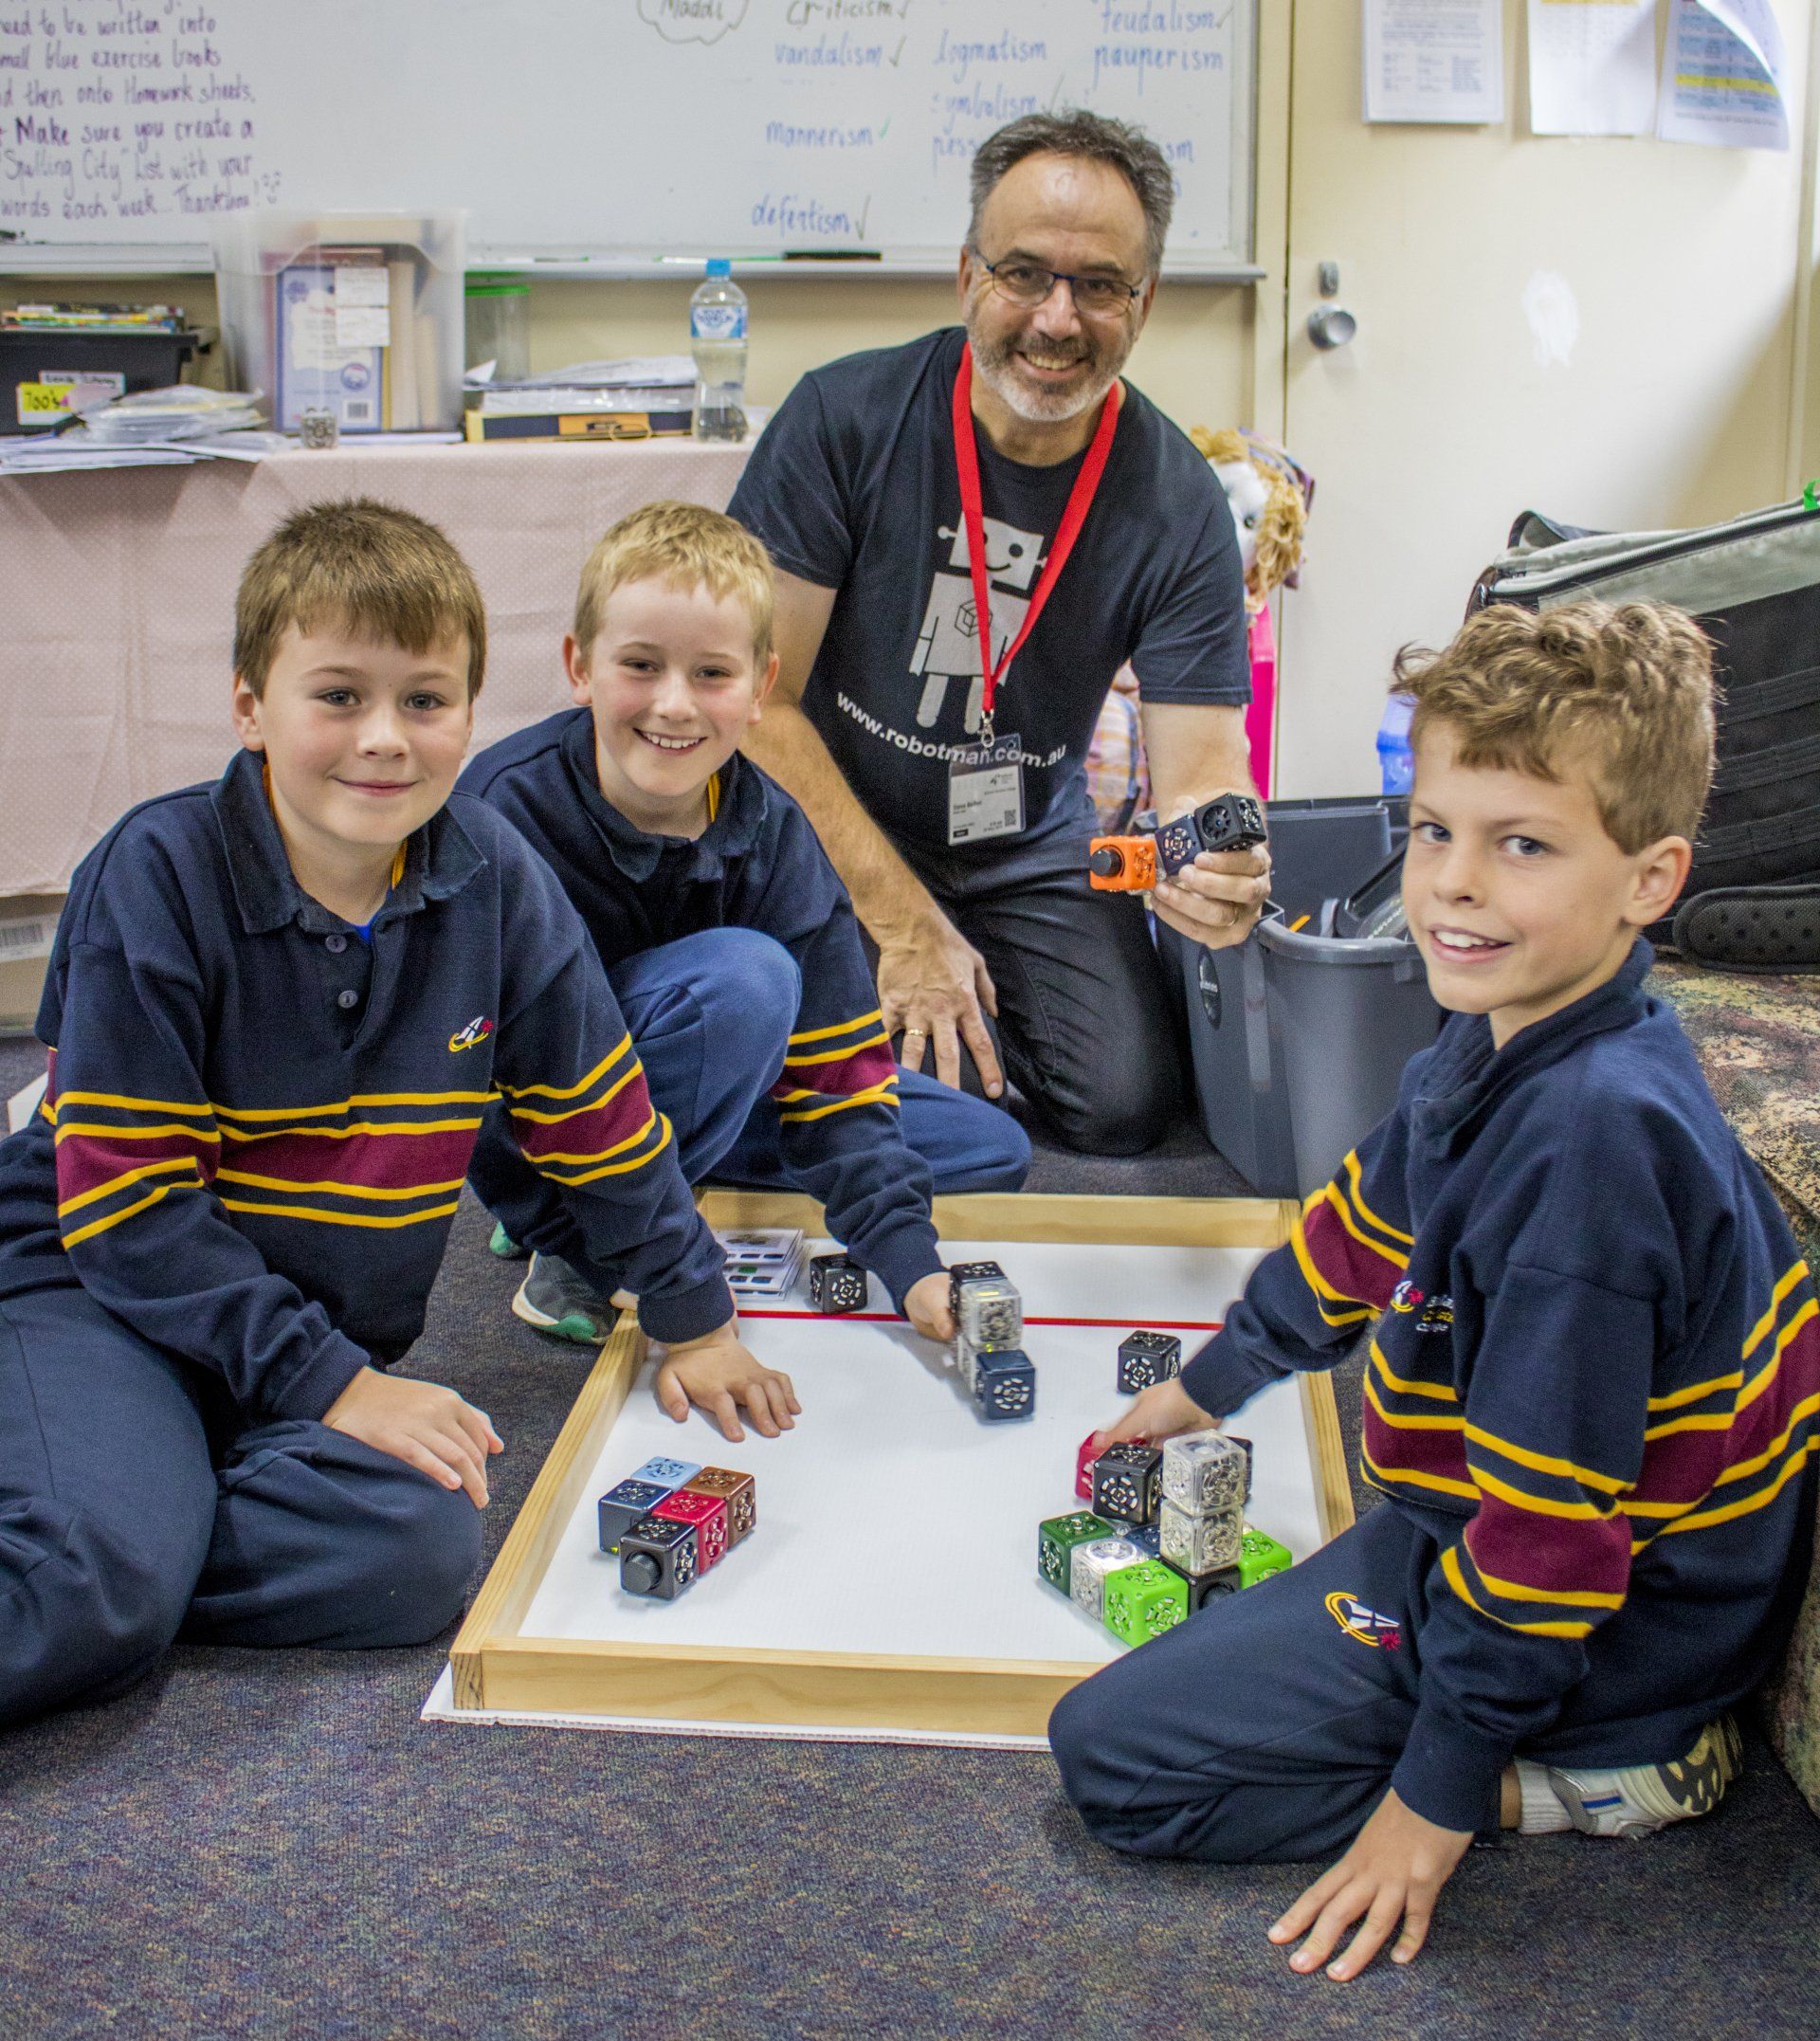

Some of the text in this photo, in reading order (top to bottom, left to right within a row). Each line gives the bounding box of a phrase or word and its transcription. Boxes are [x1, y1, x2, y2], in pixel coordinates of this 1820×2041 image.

[774, 30, 883, 67] vandalism
[1092, 45, 1225, 98] pauperism
[14, 114, 70, 146] Make
[241, 119, 254, 139] a
[765, 120, 873, 149] mannerism
[837, 691, 1067, 769] www.robotman.com.au
